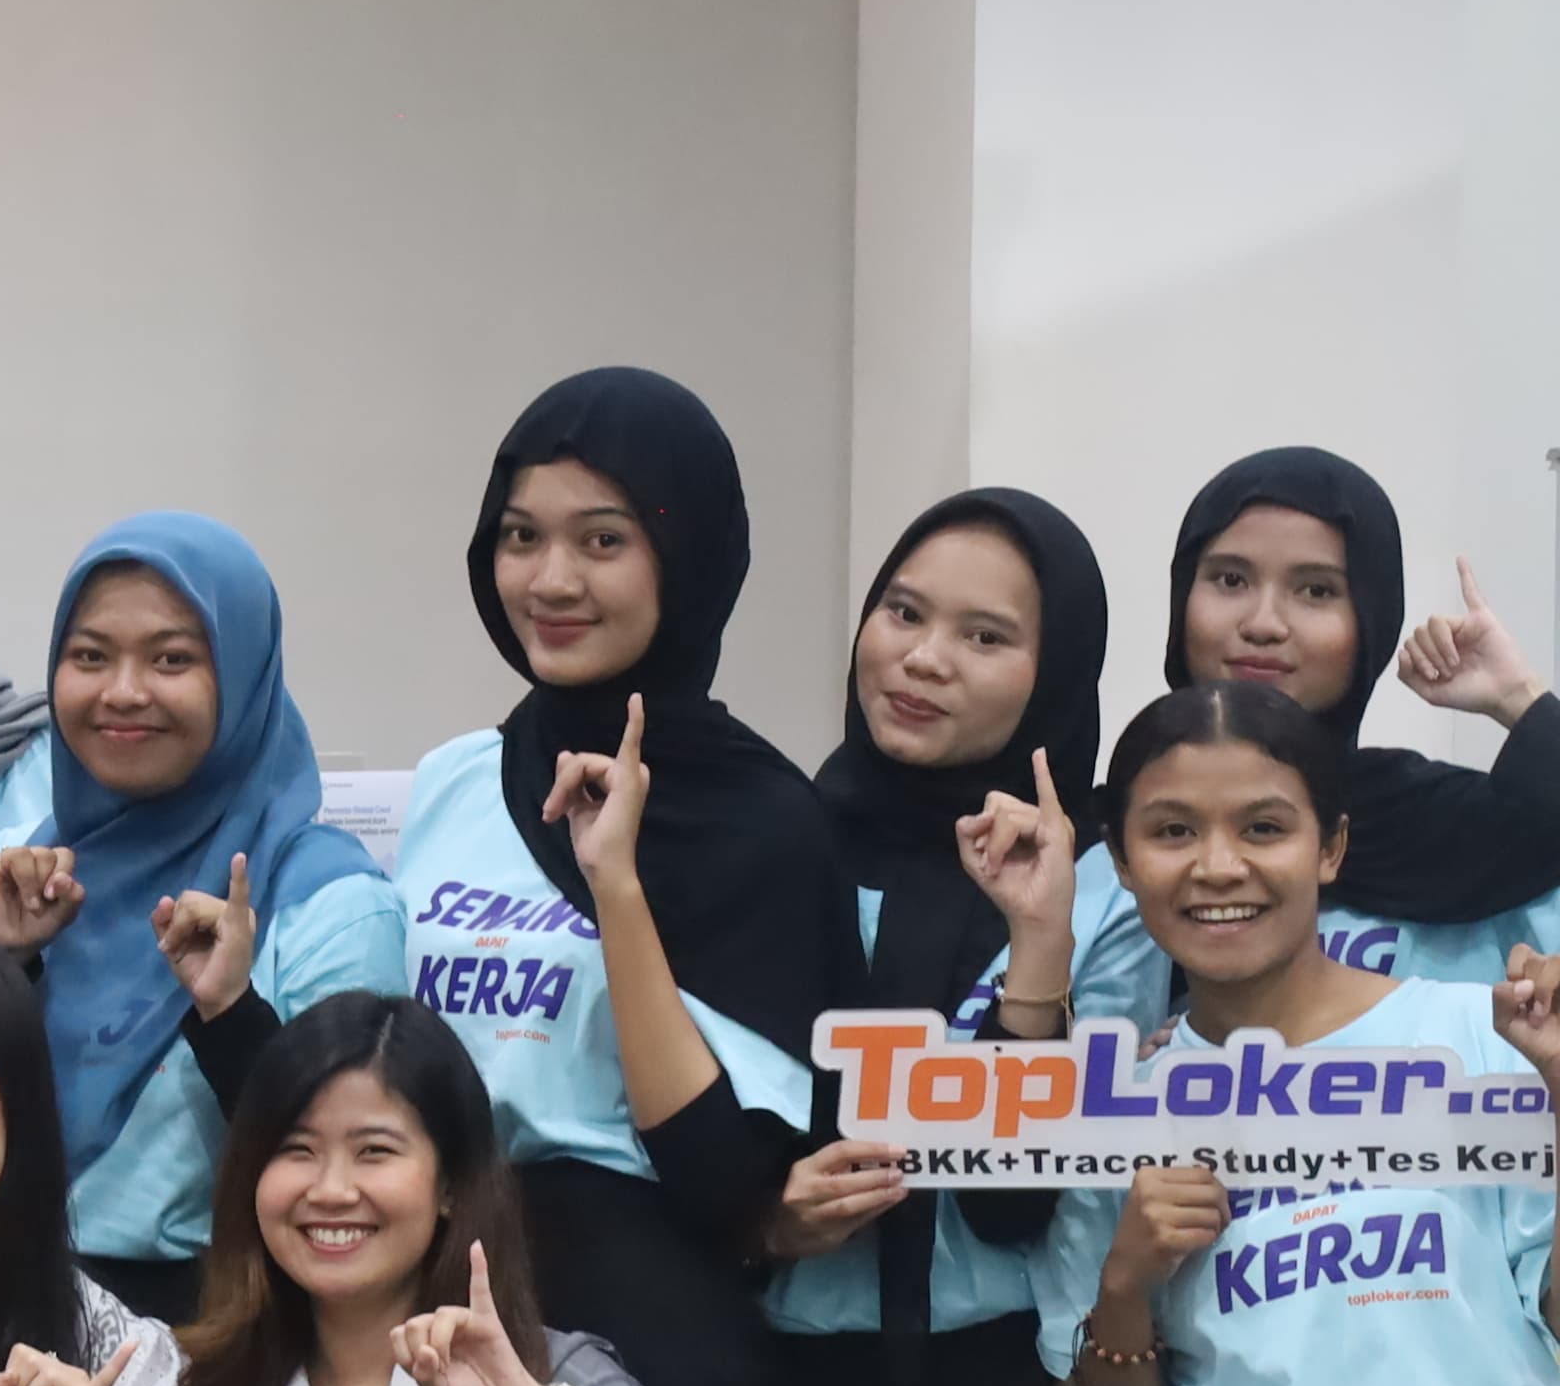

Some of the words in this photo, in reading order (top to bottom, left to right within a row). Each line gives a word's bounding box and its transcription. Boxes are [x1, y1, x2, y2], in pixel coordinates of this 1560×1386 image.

[415, 954, 574, 1022] KERJA
[830, 1024, 1555, 1138] TopLoker.co
[1456, 1143, 1555, 1178] Kerj
[1292, 1203, 1339, 1226] DAPAT
[1214, 1211, 1447, 1316] KERJA
[1347, 1287, 1451, 1307] toploker.com
